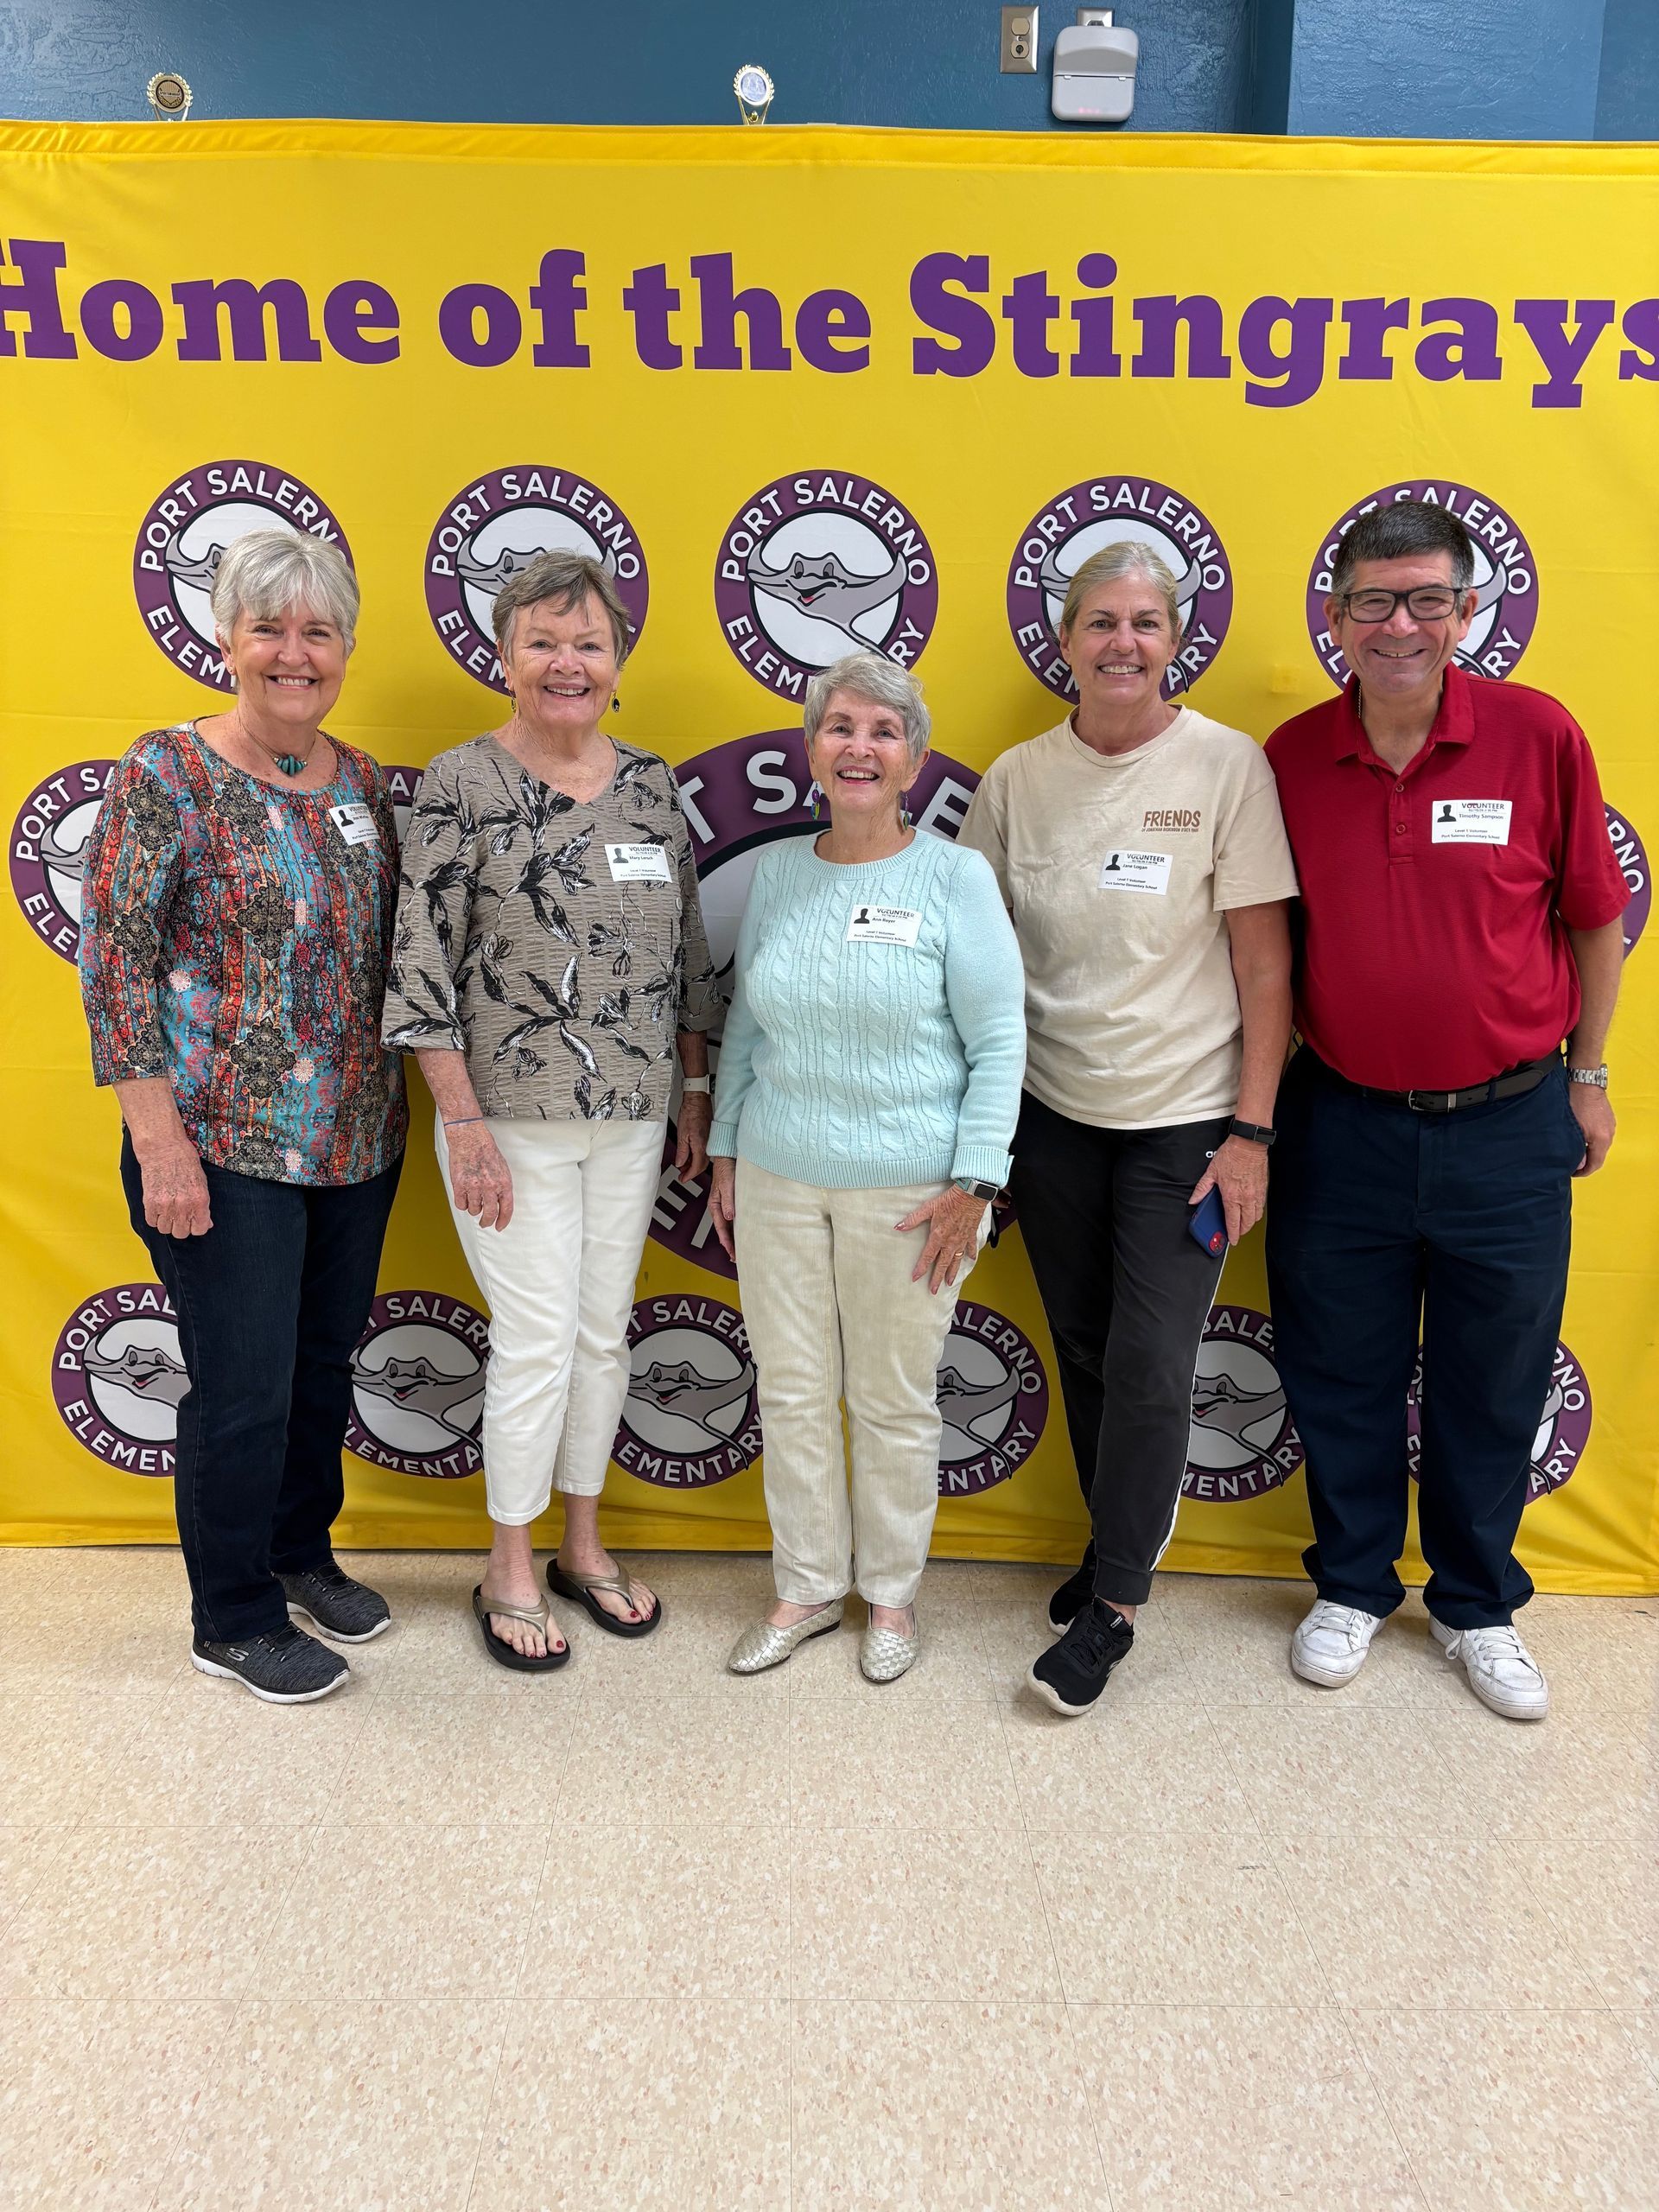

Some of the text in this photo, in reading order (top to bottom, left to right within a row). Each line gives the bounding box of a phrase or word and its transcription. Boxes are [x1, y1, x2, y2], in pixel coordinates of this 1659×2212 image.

[0, 239, 1659, 409] Home of the Stingrays
[140, 467, 343, 573] PORT SALERN
[431, 472, 641, 579] PORT SALERNO
[721, 476, 931, 586] PORT SALERNO
[1014, 482, 1226, 592] PORT SALERNO
[16, 777, 72, 862] PORT
[1127, 853, 1165, 862] VOLUNTEER
[1143, 809, 1201, 828] FRIENDS
[876, 907, 915, 918] VOLUNTEER
[59, 1298, 112, 1371] PORT
